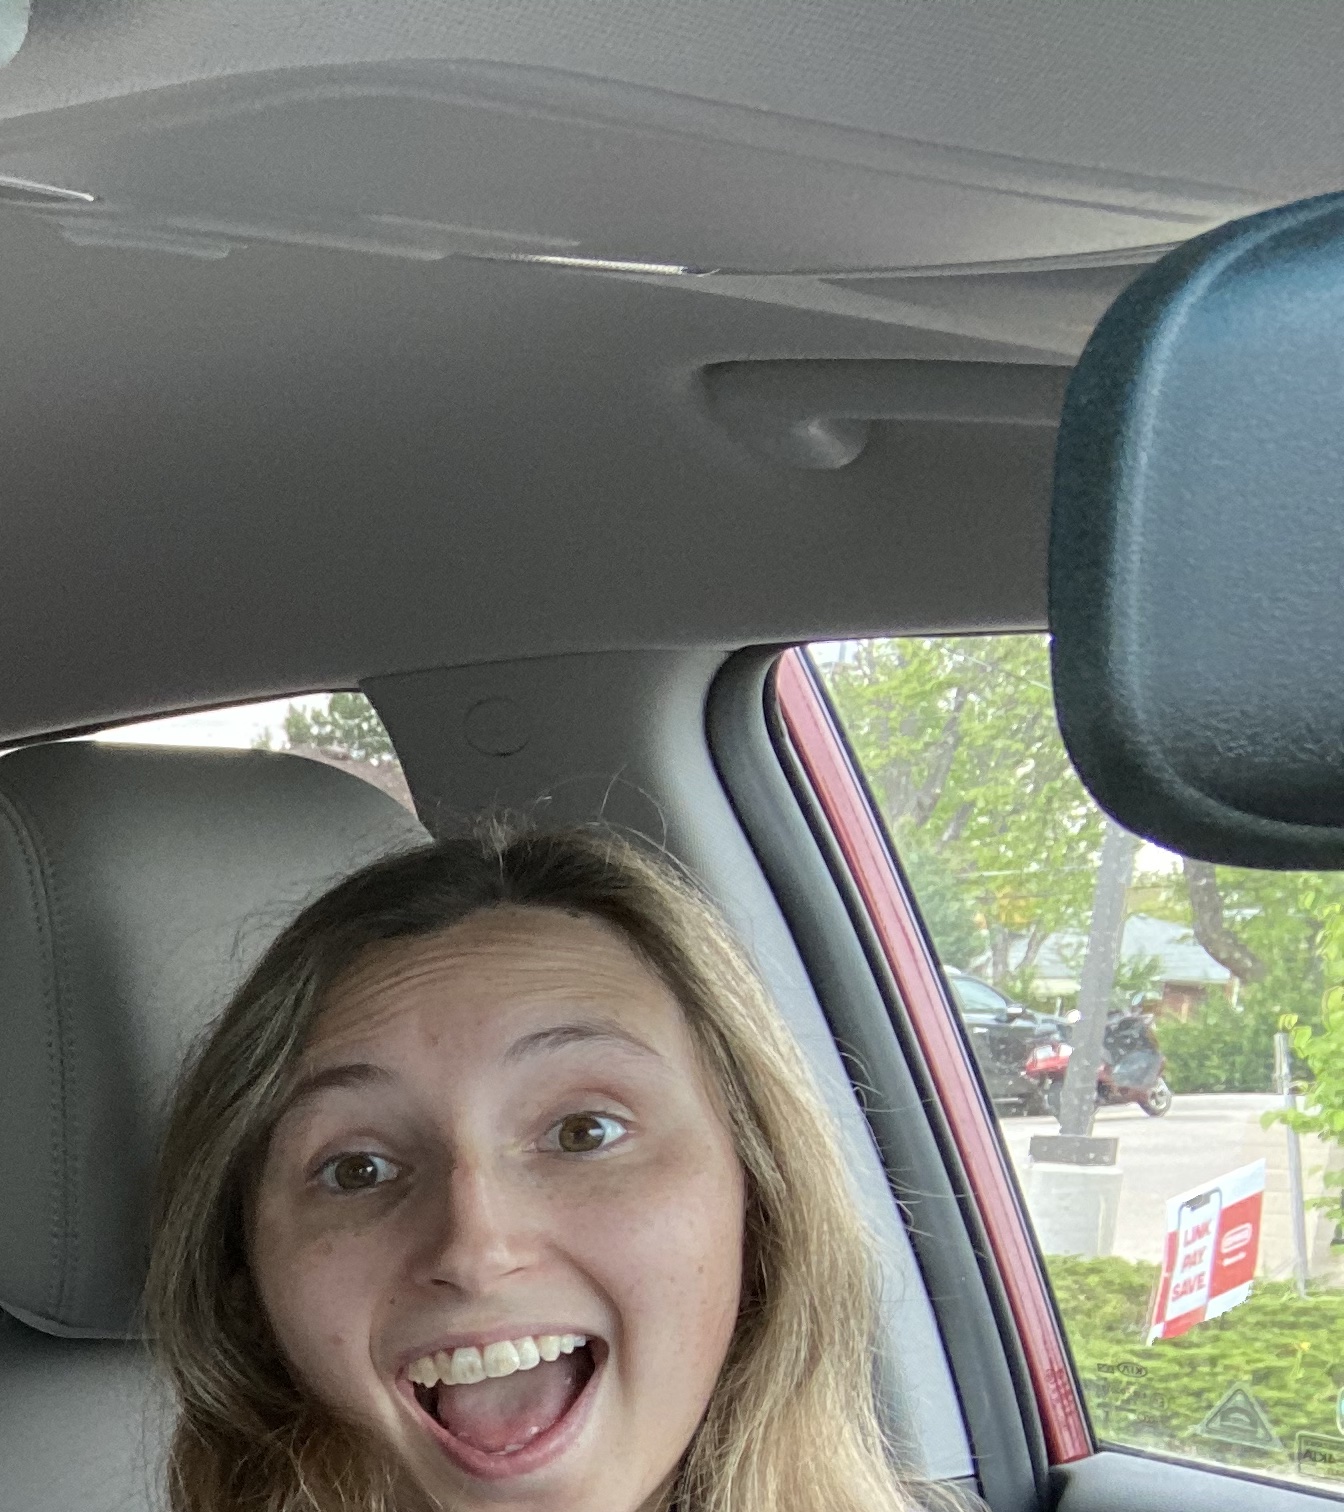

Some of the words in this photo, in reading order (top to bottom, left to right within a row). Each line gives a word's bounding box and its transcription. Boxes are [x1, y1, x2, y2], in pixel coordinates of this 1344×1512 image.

[1184, 1220, 1211, 1246] LINK
[1182, 1247, 1206, 1271] PAY
[1172, 1273, 1205, 1302] SAVE
